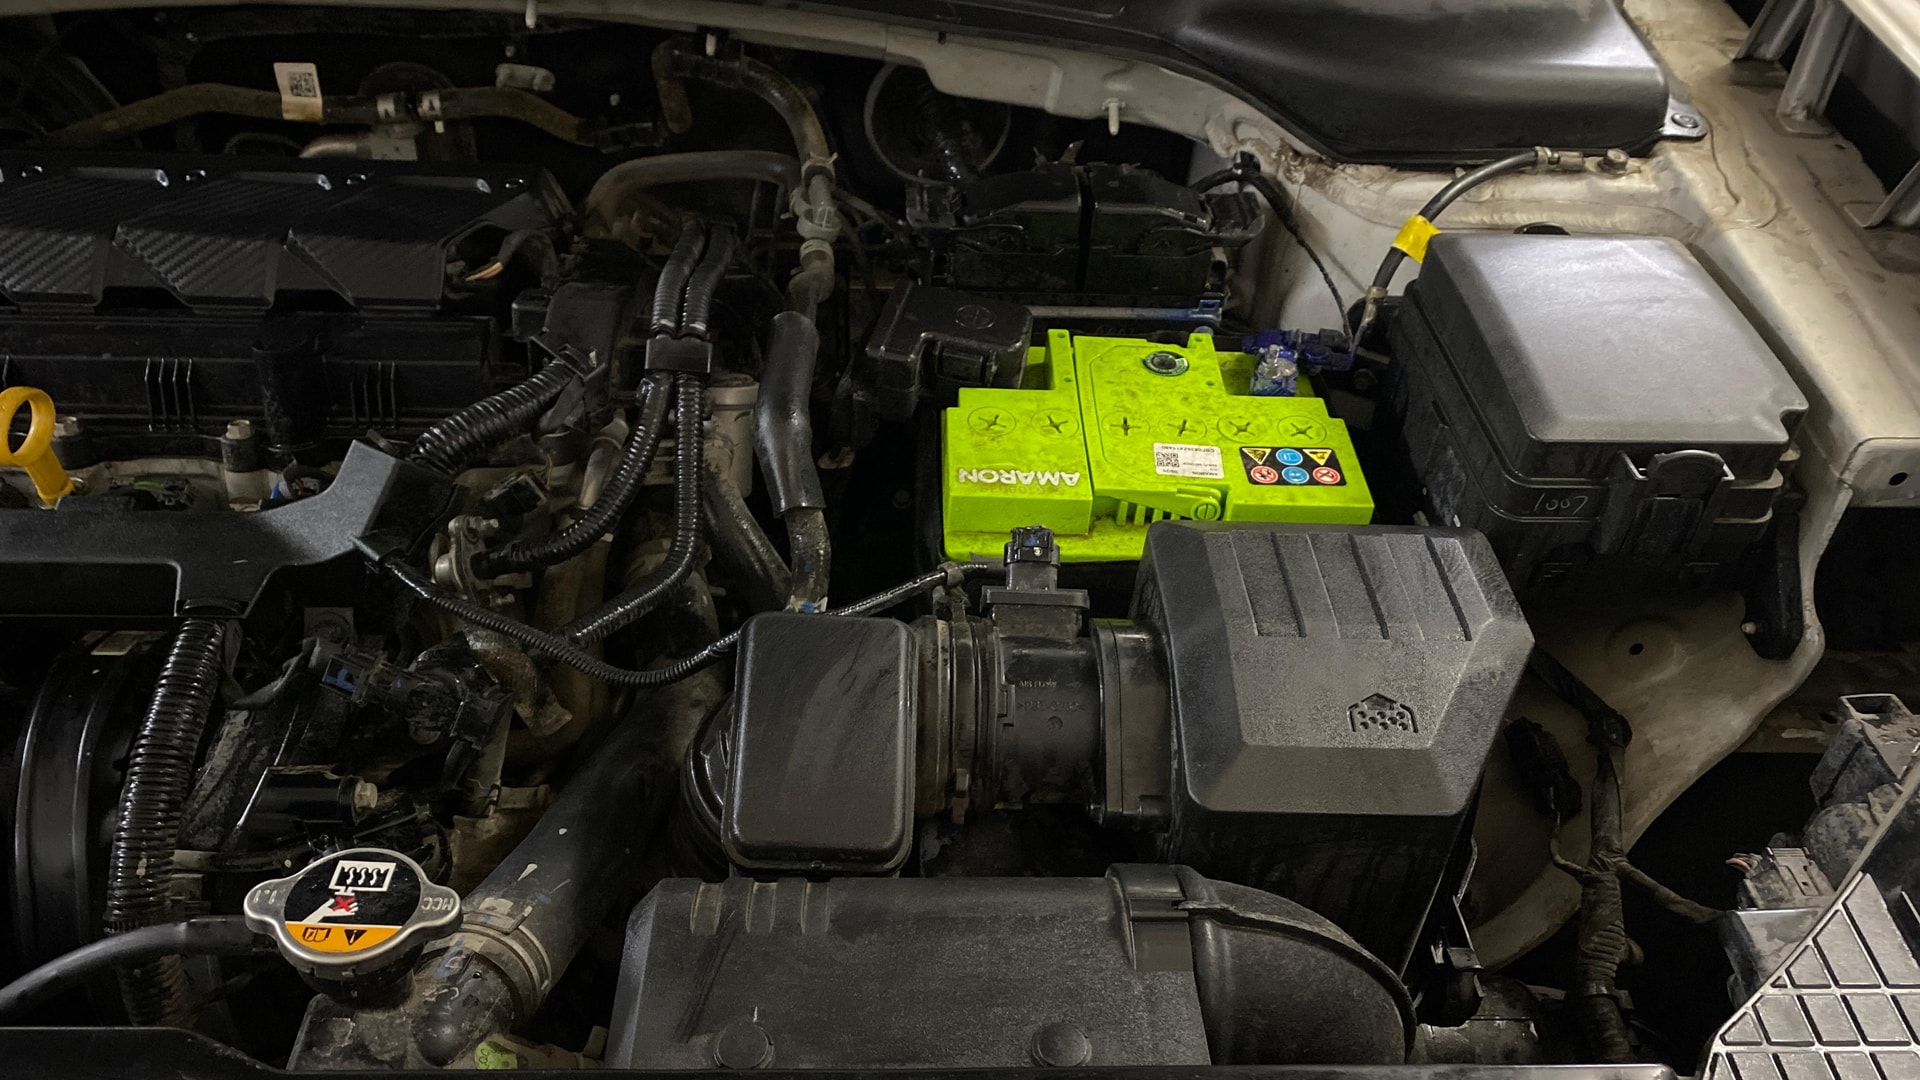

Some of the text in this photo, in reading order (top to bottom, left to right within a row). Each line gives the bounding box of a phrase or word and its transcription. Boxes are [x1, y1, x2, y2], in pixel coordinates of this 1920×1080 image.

[958, 467, 1080, 487] AMARON
[1533, 492, 1589, 515] 1007
[253, 889, 454, 912] 1.1 MCC
